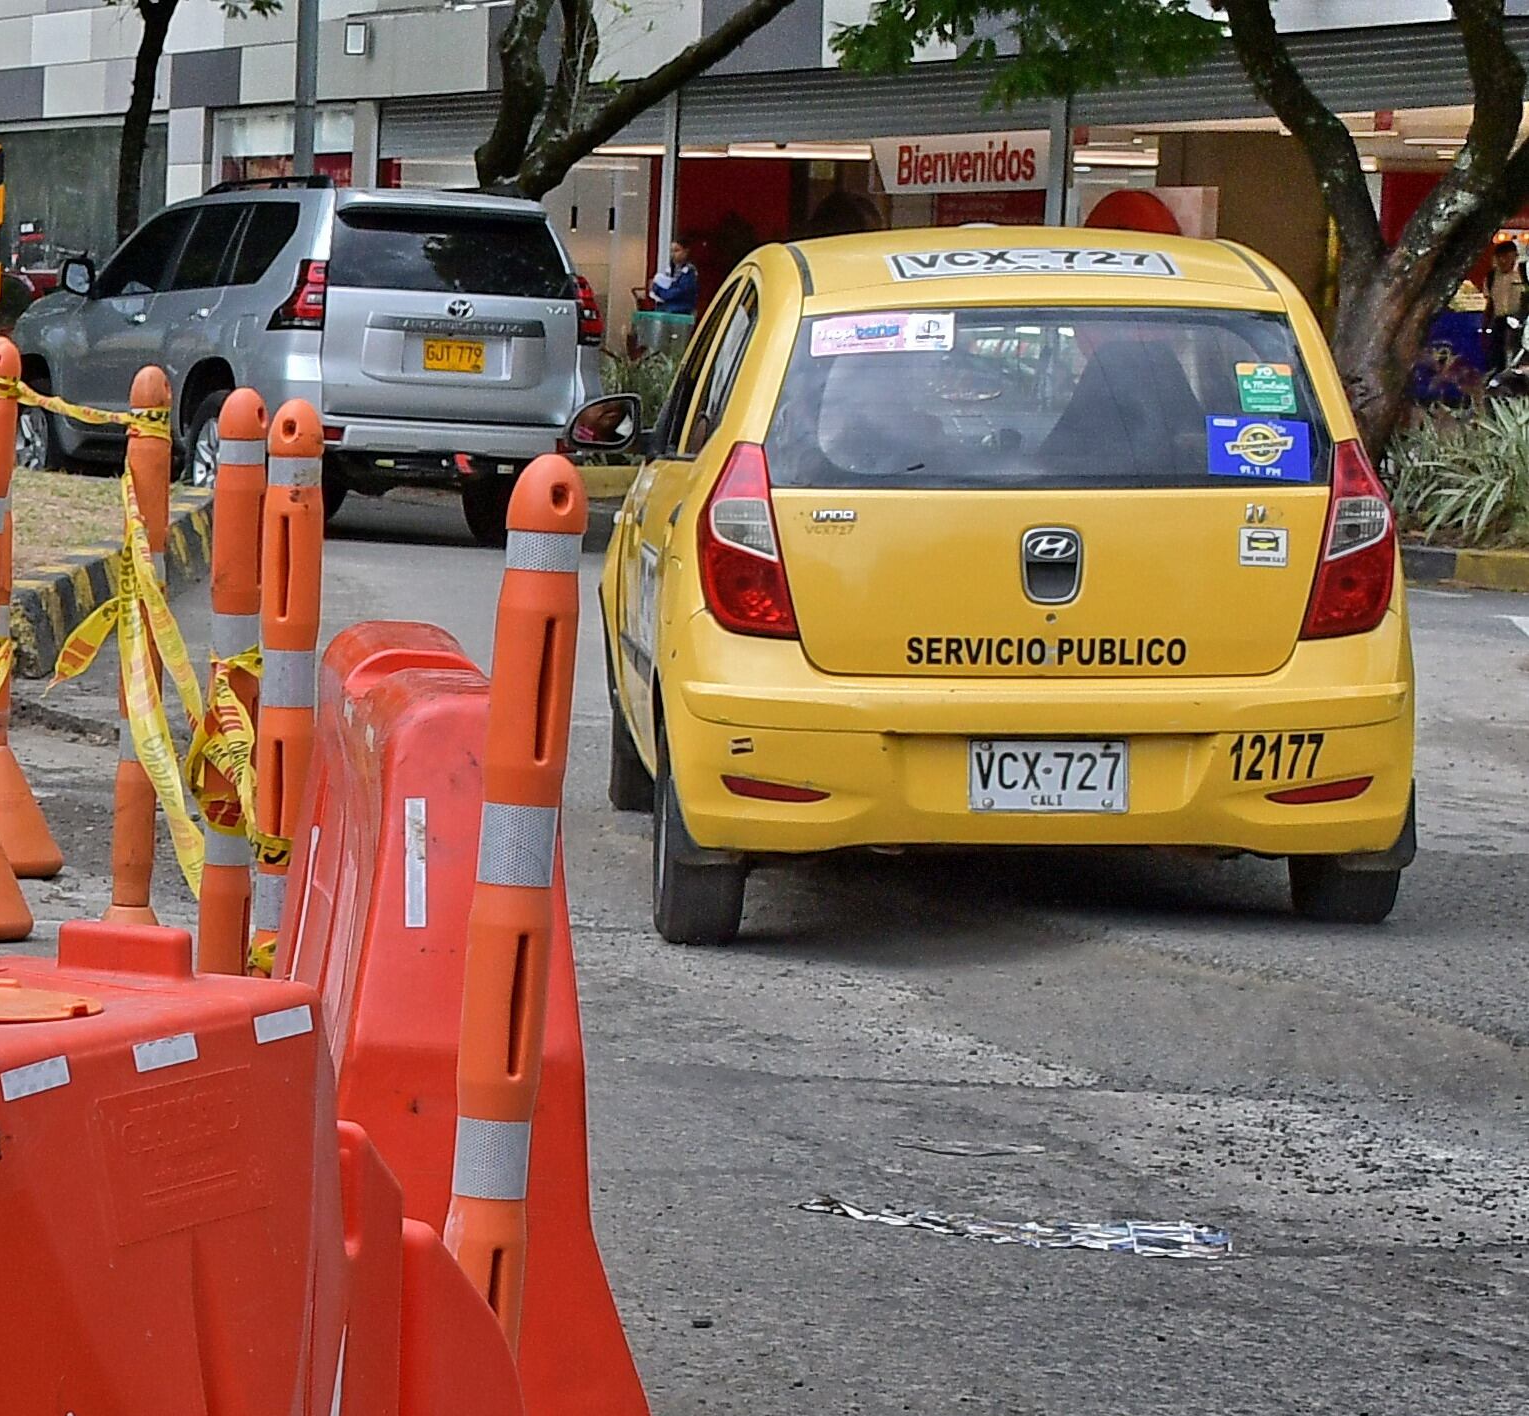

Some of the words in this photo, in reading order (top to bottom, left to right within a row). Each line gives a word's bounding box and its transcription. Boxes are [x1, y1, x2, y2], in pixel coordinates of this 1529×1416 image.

[896, 139, 1036, 186] Bienvenidos
[426, 344, 452, 363] GJT
[457, 346, 483, 365] 779
[906, 636, 1046, 666] SERVICIO
[1057, 637, 1187, 667] PUBLICO
[1229, 732, 1326, 781] 12177
[1030, 794, 1063, 807] CALI
